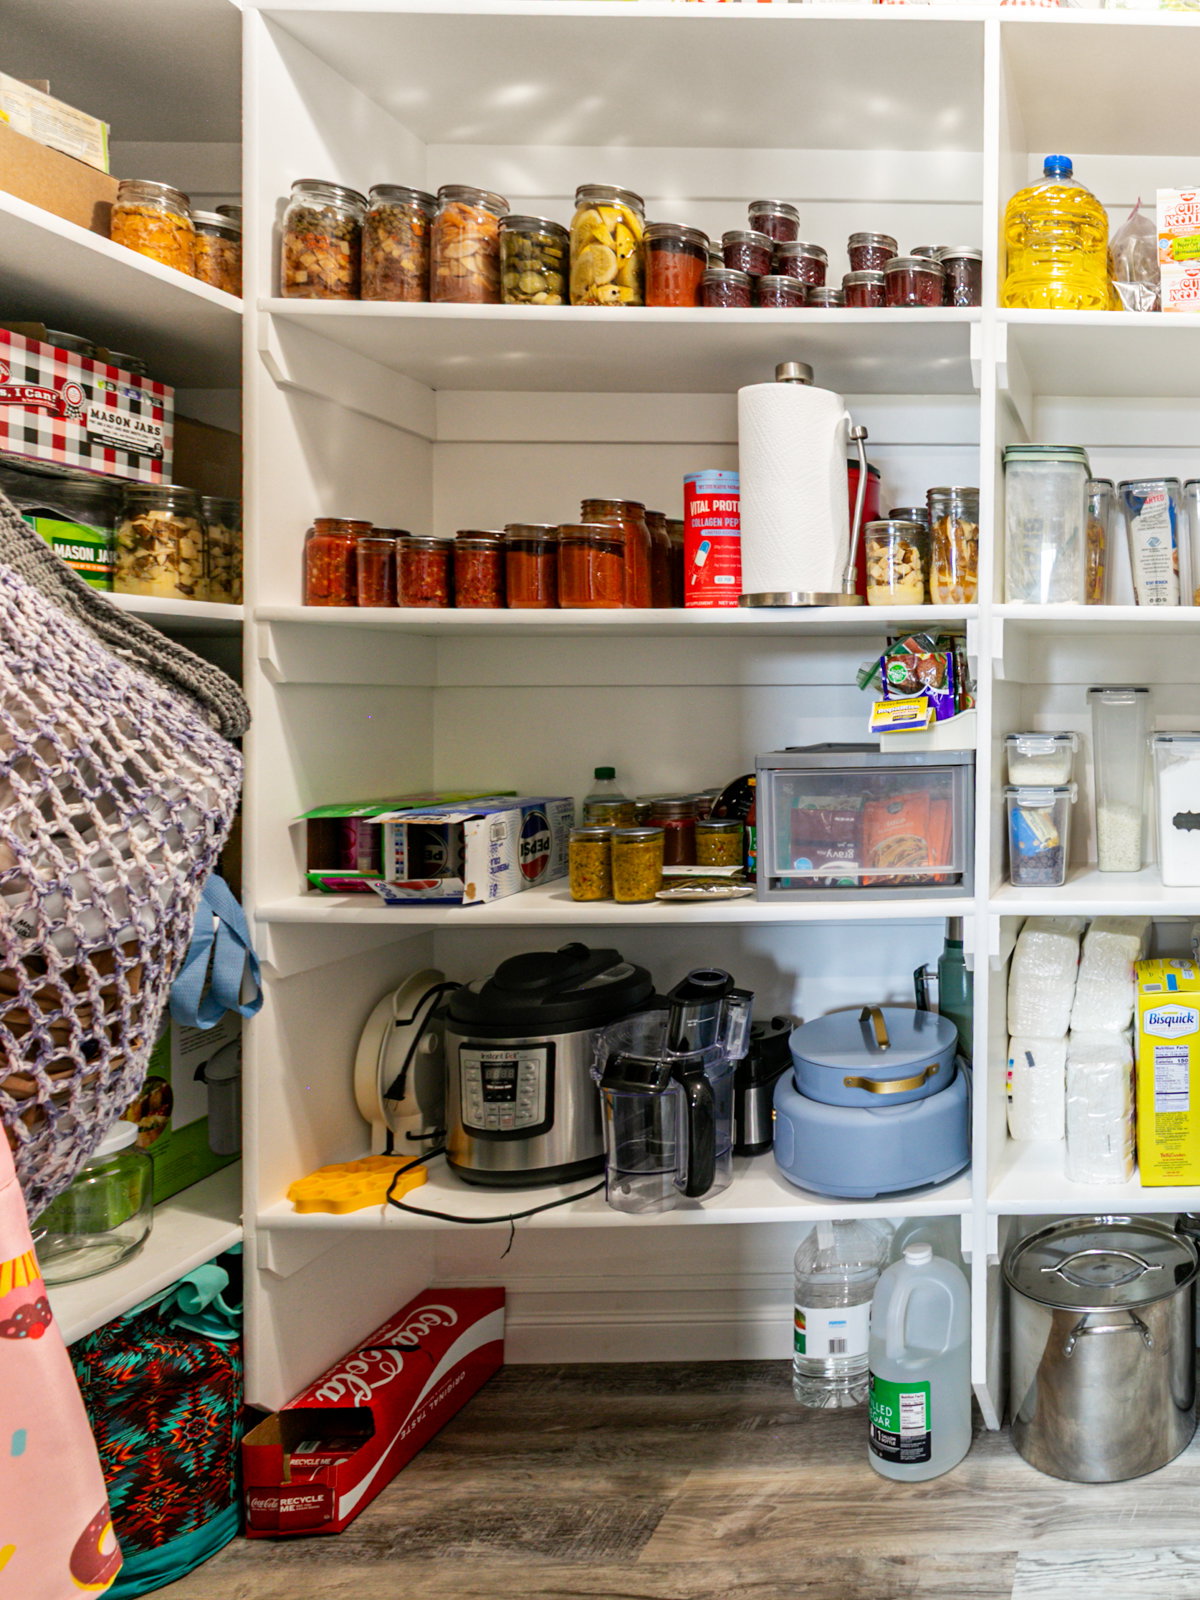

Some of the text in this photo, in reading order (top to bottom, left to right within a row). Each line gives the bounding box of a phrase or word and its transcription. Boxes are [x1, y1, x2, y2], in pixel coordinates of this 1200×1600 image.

[1175, 203, 1200, 216] CUP
[14, 388, 22, 397] I
[24, 389, 57, 401] Can!
[90, 408, 161, 436] MASON JARS
[690, 500, 740, 516] VITAL PROT
[692, 518, 740, 528] COLLAGEN PEP
[54, 543, 94, 562] MASON
[520, 837, 550, 858] PEPSI
[826, 848, 854, 858] gravy
[1149, 1012, 1194, 1028] Bisquick
[400, 1370, 466, 1440] ORIGINAL TASTE
[290, 1458, 320, 1466] RECYCLE
[280, 1494, 324, 1506] RECYCLE
[280, 1504, 296, 1512] ME
